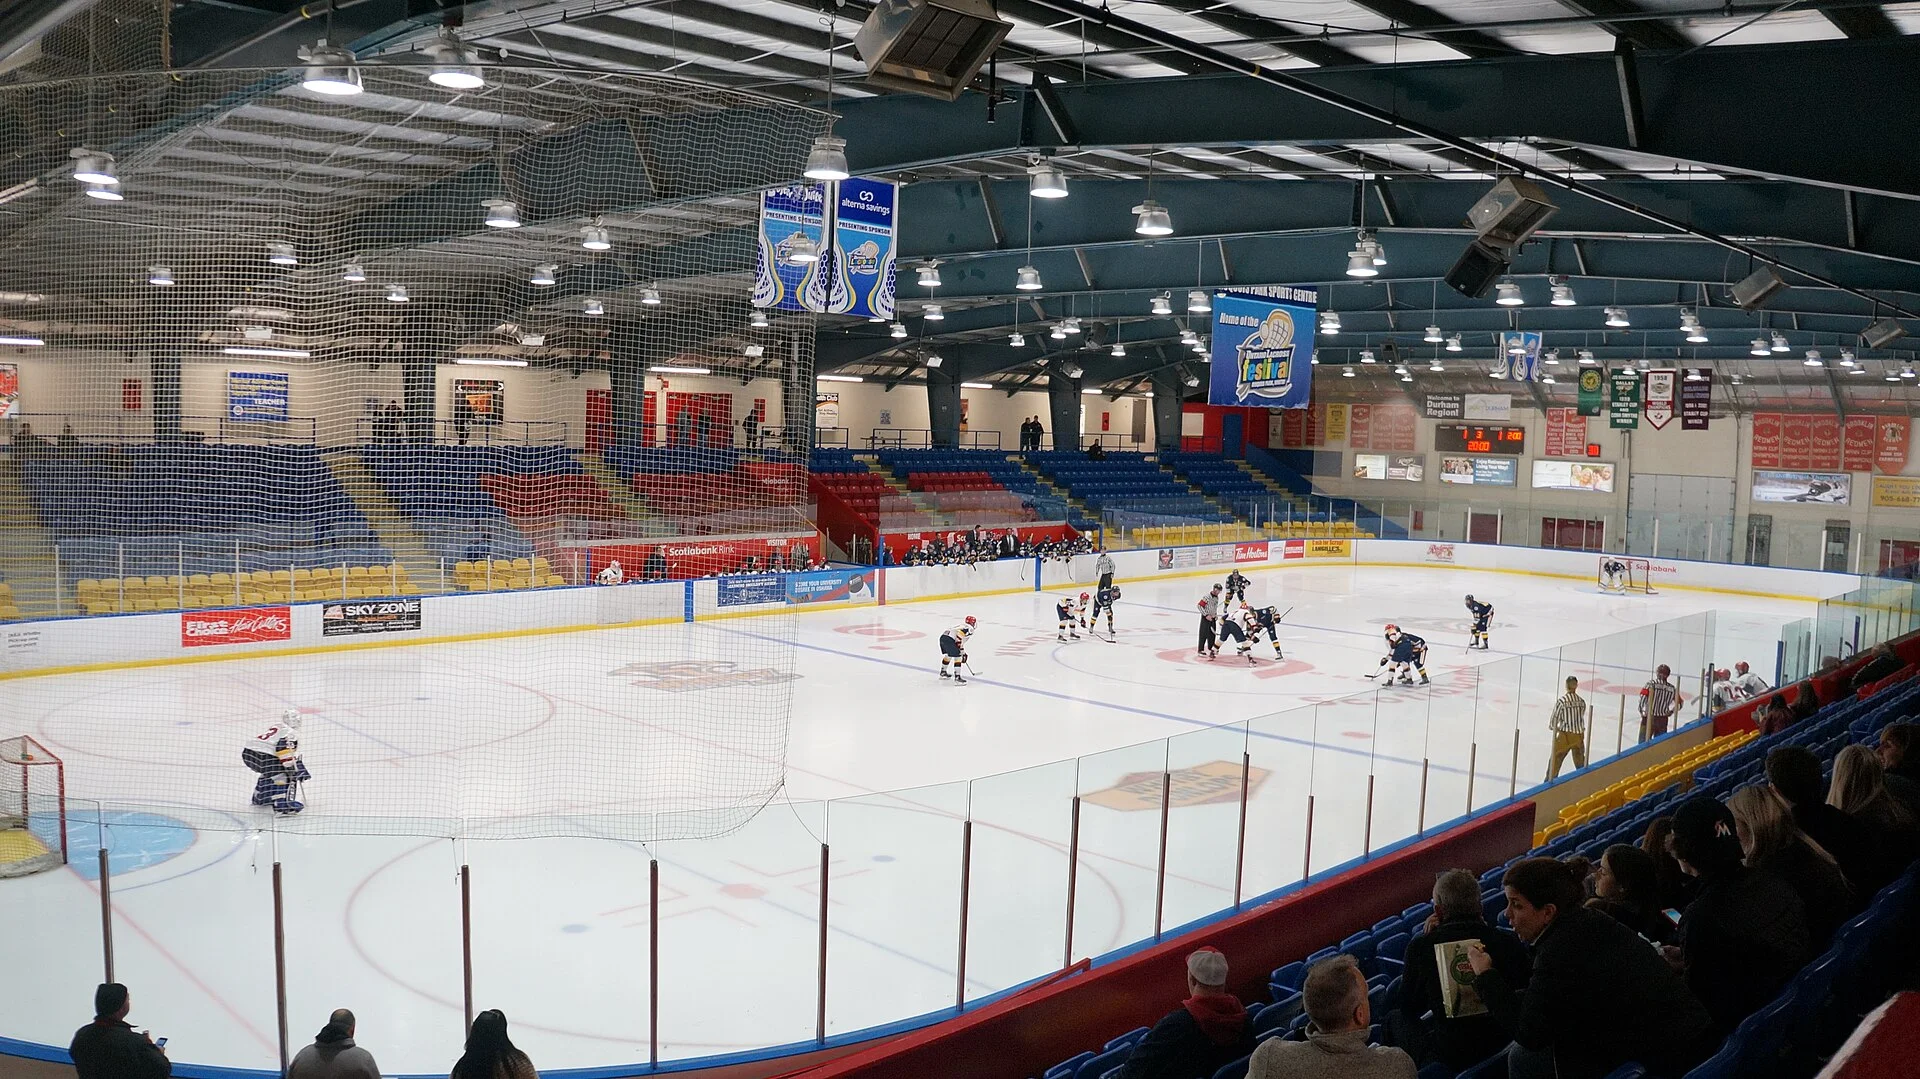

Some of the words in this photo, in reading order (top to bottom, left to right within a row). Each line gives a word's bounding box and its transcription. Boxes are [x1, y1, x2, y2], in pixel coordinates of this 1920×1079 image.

[841, 197, 866, 210] alterna
[865, 203, 890, 216] savings
[797, 217, 823, 226] SONSOR
[838, 221, 868, 232] PRESENTING
[868, 226, 891, 236] SPONSOR
[1250, 286, 1268, 297] PARK
[1268, 285, 1293, 300] SPORTS
[1293, 288, 1317, 304] CENTRE
[1219, 312, 1239, 325] Home
[1240, 315, 1247, 326] of
[1247, 316, 1259, 328] the
[1242, 356, 1290, 382] festival
[1426, 400, 1460, 409] Durham
[1426, 408, 1459, 418] Region!
[1463, 429, 1468, 440] 1
[1476, 430, 1483, 439] 3
[1498, 430, 1503, 441] 1
[1754, 433, 1780, 444] REDMEN
[1467, 439, 1491, 452] 20:00
[1784, 435, 1811, 446] REDMEN
[1813, 436, 1840, 446] REDMEN
[1845, 437, 1874, 448] REDMEN
[1588, 445, 1599, 456] 30
[907, 532, 921, 540] HOME
[767, 538, 787, 547] VISITOR
[669, 545, 720, 557] Scotiabank
[719, 544, 735, 554] Rink
[1235, 547, 1247, 560] Tim
[1246, 546, 1268, 560] Hortons
[345, 604, 377, 616] SKY
[378, 602, 420, 614] ZONE
[186, 620, 229, 629] First
[185, 628, 229, 637] Choice
